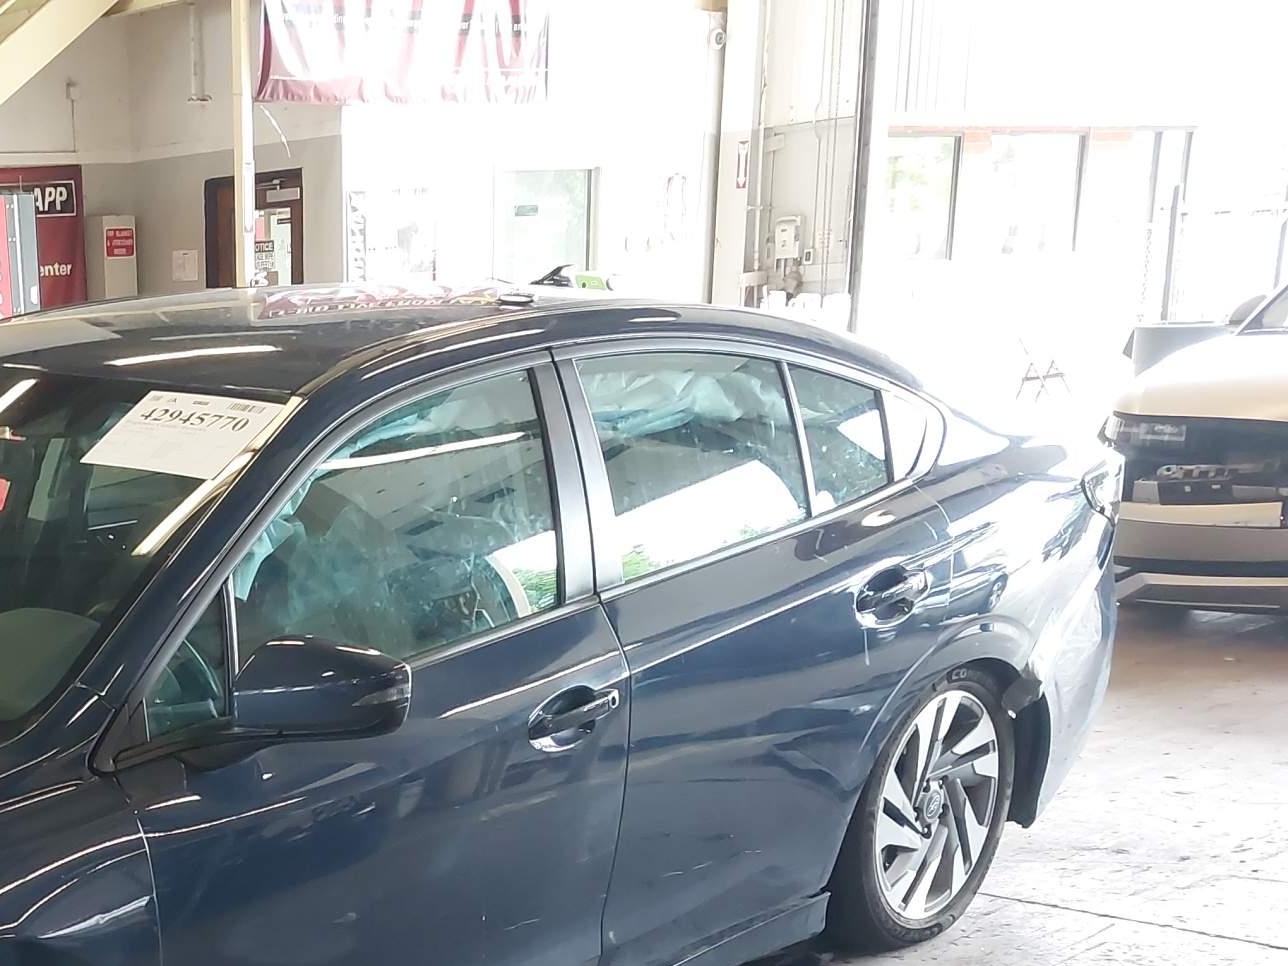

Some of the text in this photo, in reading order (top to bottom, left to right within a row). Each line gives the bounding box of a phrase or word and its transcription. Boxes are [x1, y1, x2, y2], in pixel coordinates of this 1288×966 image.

[33, 186, 67, 211] APP
[39, 262, 72, 277] enter
[141, 407, 250, 432] 42945770
